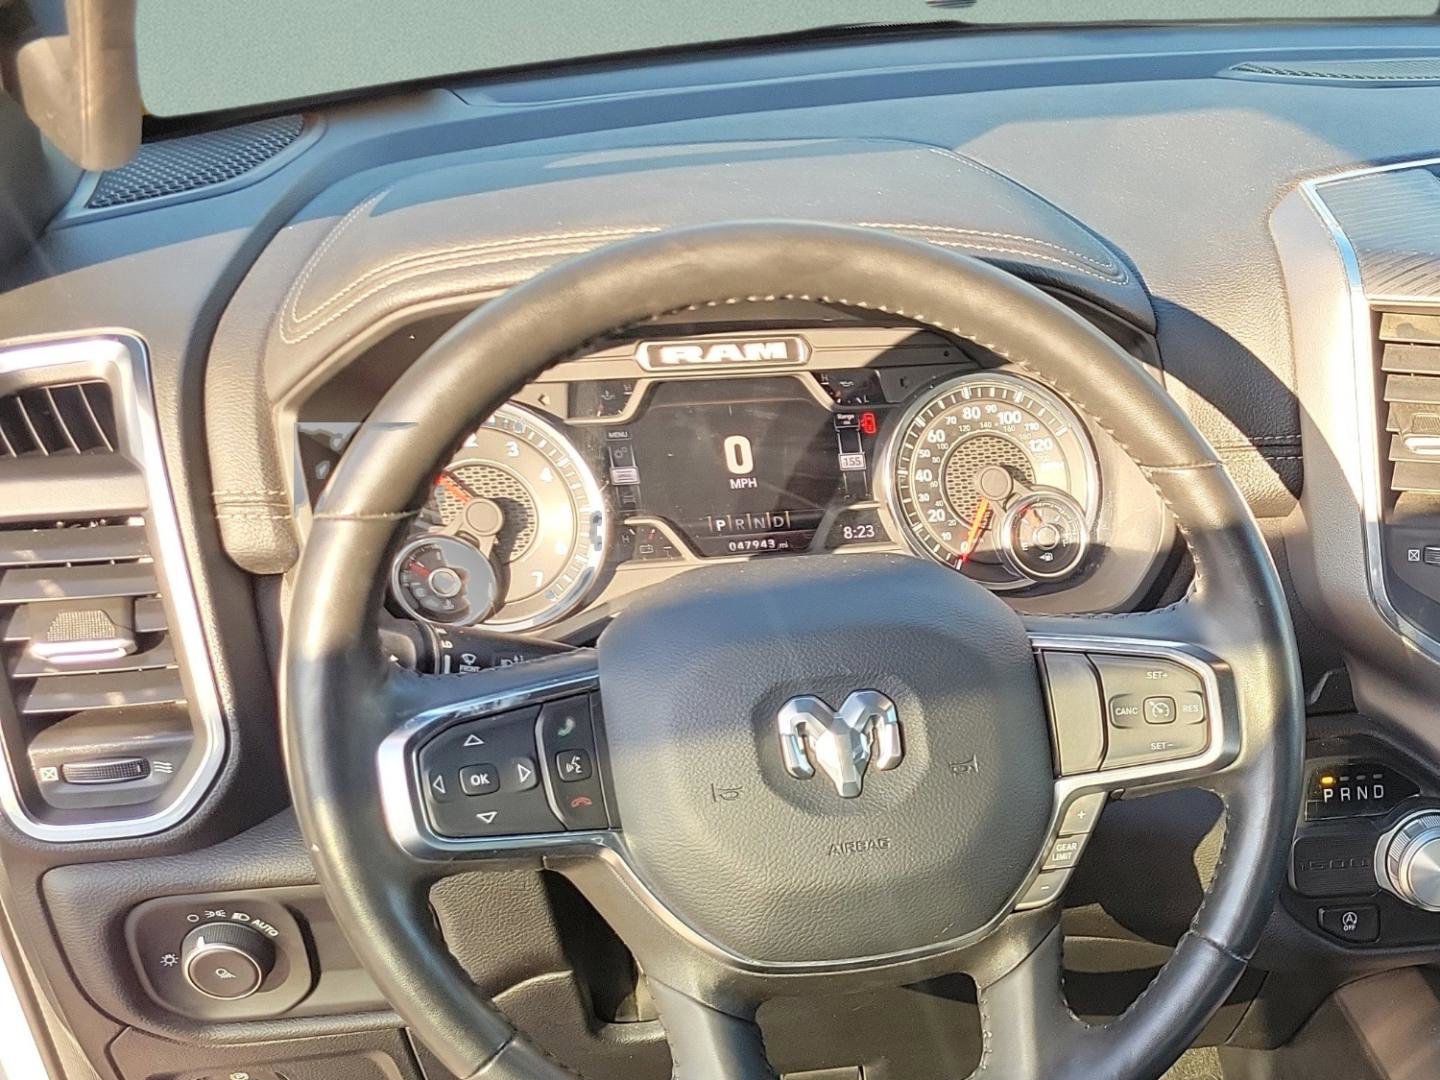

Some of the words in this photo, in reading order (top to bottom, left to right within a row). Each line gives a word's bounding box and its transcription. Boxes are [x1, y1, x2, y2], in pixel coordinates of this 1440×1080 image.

[659, 342, 788, 364] RAM
[962, 406, 981, 420] 80
[985, 404, 997, 413] 90
[945, 416, 957, 425] 70
[997, 411, 1022, 424] 100
[980, 421, 992, 429] 140
[927, 429, 946, 443] 60
[505, 441, 520, 457] 3
[1029, 438, 1053, 451] 120
[724, 435, 754, 475] 0
[919, 449, 931, 458] 50
[843, 456, 863, 467] 155
[915, 468, 933, 482] 40
[729, 477, 758, 490] MPH
[929, 480, 939, 488] 60
[918, 493, 930, 502] 30
[927, 508, 946, 522] 20
[716, 519, 726, 532] P
[735, 518, 745, 531] R
[754, 517, 766, 529] N
[773, 515, 784, 528] D
[843, 524, 875, 539] 8:23
[941, 532, 952, 540] 10
[728, 539, 776, 552] 047943
[1115, 706, 1139, 716] CANC
[1182, 704, 1199, 713] RES
[470, 773, 490, 786] OK
[1323, 788, 1334, 803] P
[1340, 787, 1351, 802] R
[1357, 785, 1368, 800] N
[1373, 784, 1384, 799] D
[828, 837, 892, 857] AIRBAG
[1056, 842, 1078, 852] GEAR
[1052, 852, 1072, 861] LIMIT
[251, 918, 279, 937] AUTO
[1343, 924, 1356, 932] OFF
